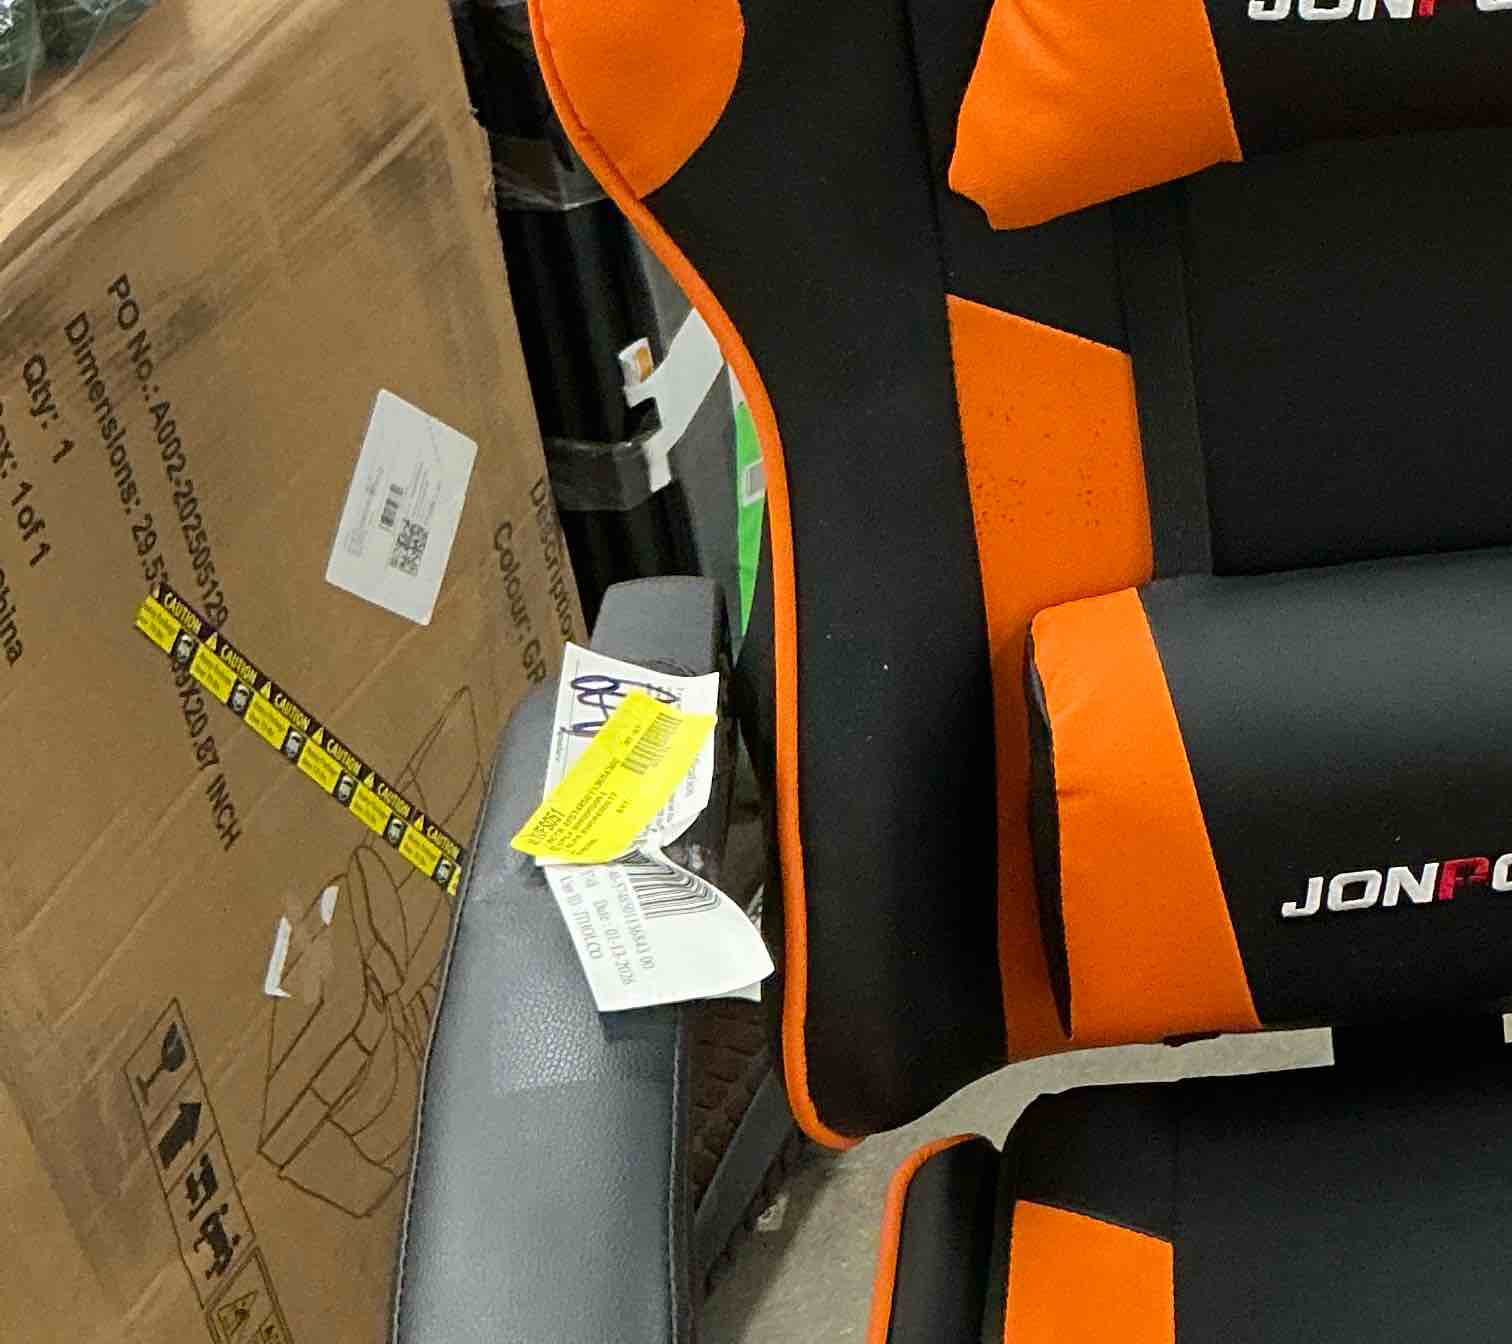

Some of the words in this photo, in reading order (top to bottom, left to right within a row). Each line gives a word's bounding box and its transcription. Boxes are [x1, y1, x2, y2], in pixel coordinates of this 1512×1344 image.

[107, 274, 140, 331] PO
[23, 354, 59, 430] Qty:
[52, 440, 75, 464] 1
[11, 481, 33, 506] 1
[18, 506, 46, 542] of
[30, 543, 51, 567] 1
[64, 311, 141, 515] Dimensions:
[206, 773, 242, 852] INCH
[162, 591, 203, 634] CAUTION
[220, 643, 258, 685] CAUTION
[274, 693, 312, 732] CAUTION
[326, 738, 363, 777] CAUTION
